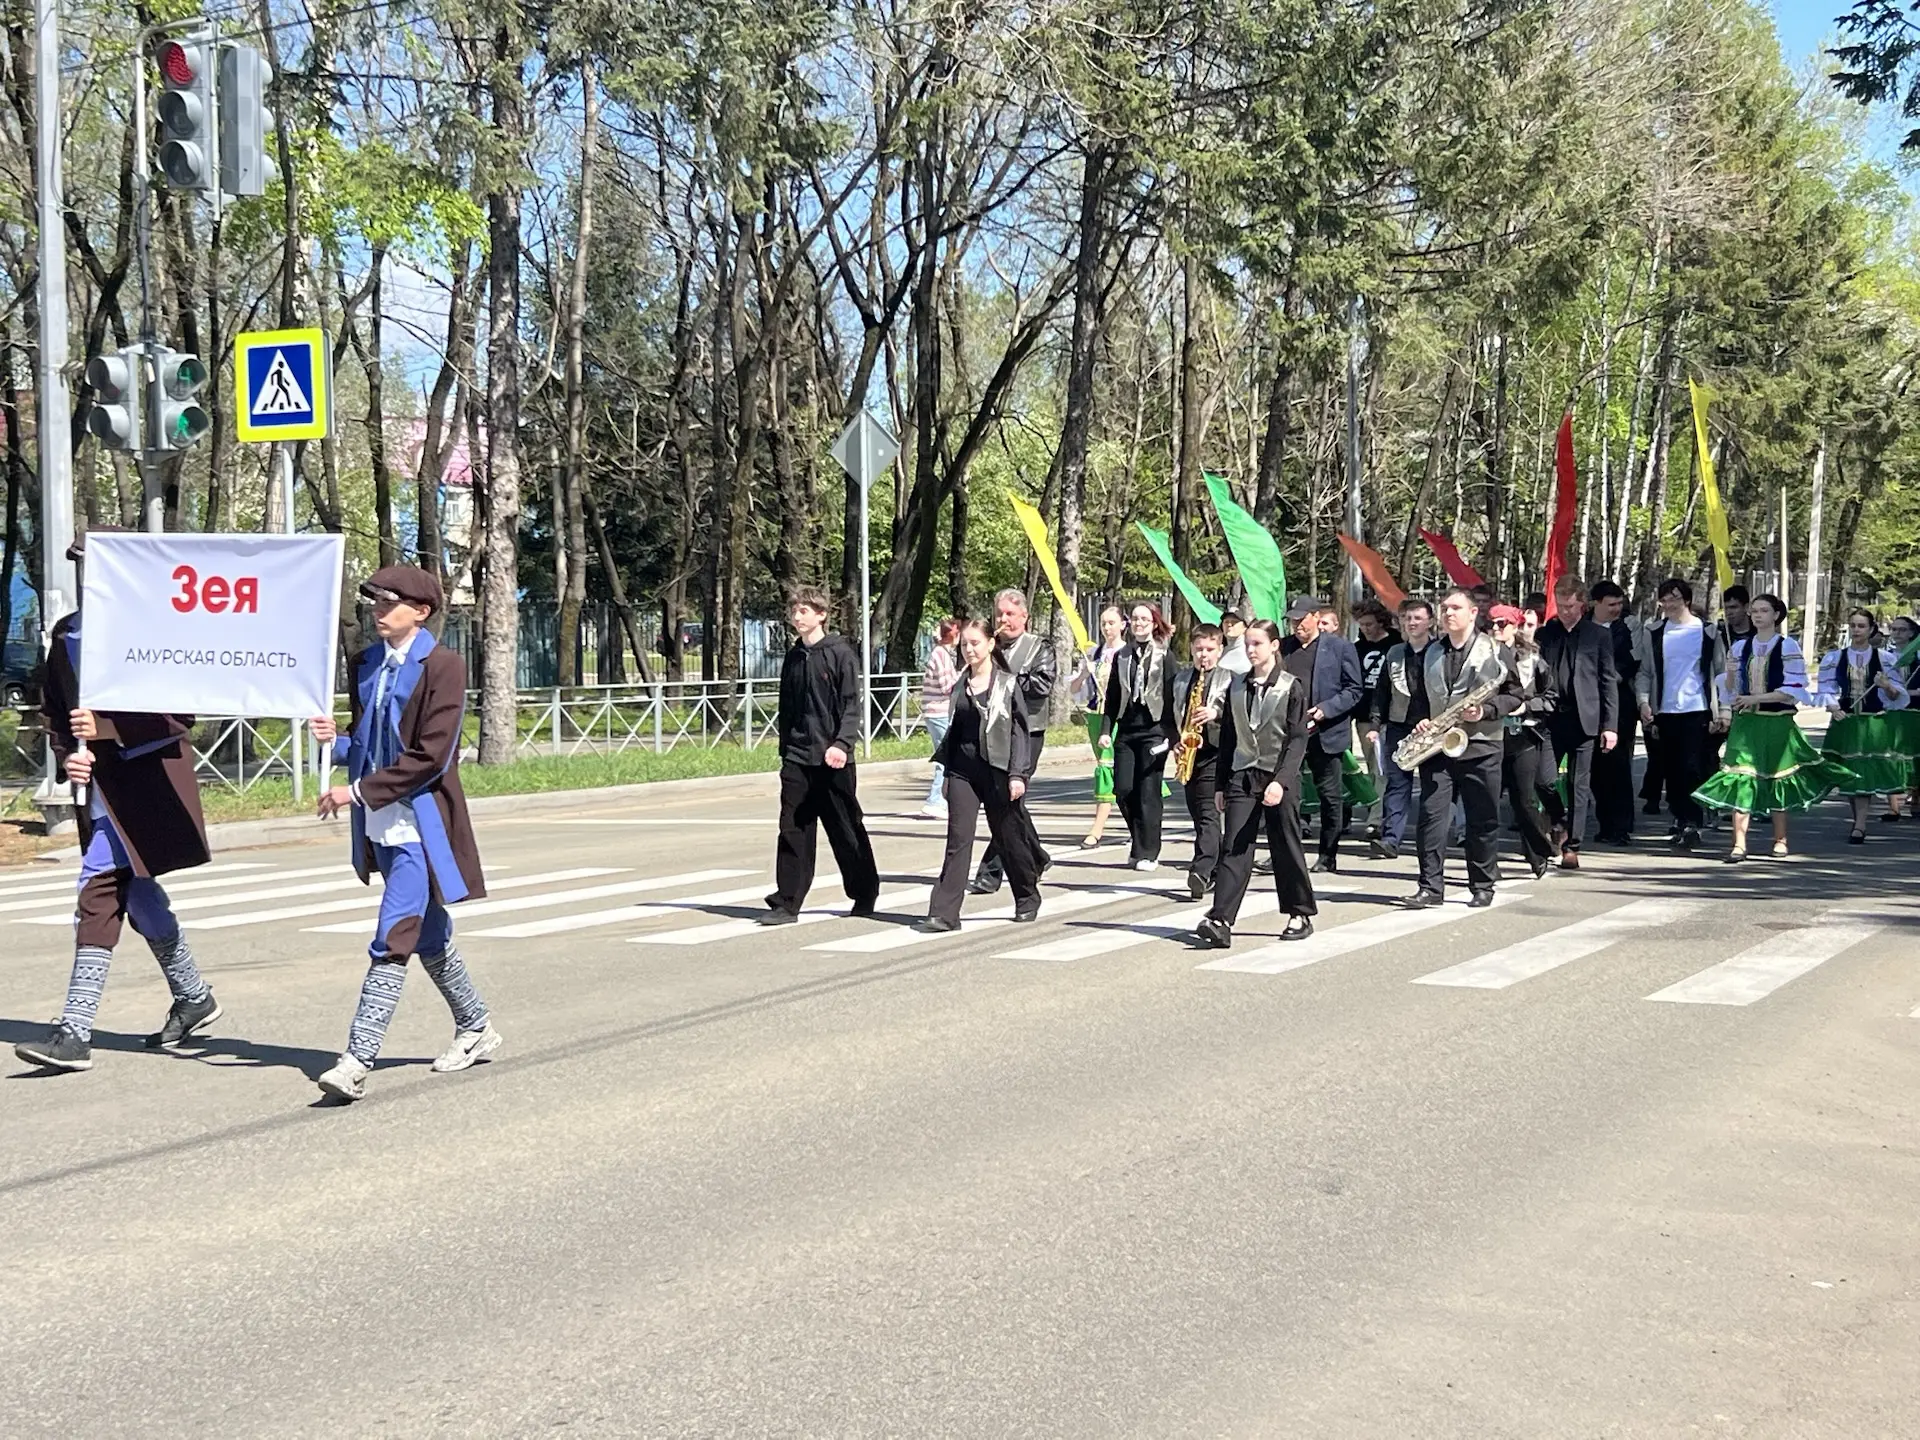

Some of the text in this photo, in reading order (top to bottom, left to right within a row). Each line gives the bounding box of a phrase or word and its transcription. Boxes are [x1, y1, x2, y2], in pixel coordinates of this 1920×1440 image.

[171, 565, 258, 614] Зея
[125, 648, 297, 668] АМУРСКАЯ ОБЛАСТЬ
